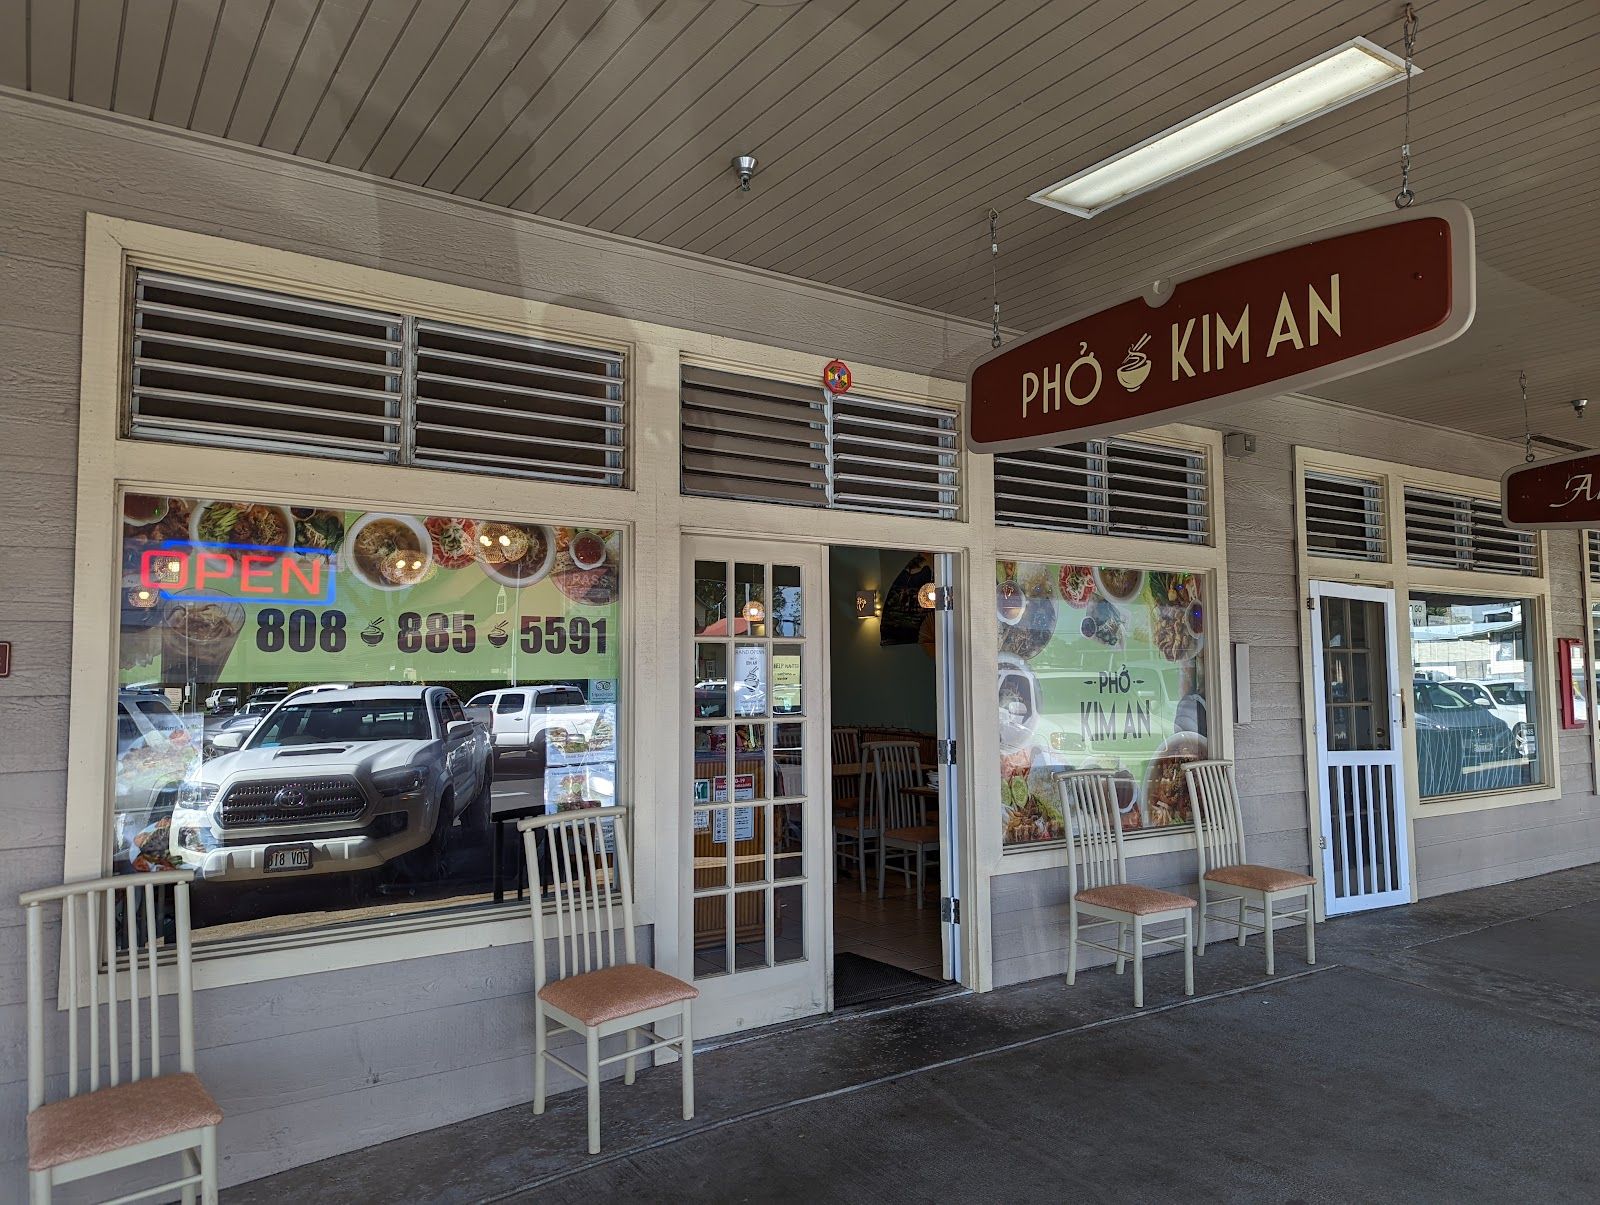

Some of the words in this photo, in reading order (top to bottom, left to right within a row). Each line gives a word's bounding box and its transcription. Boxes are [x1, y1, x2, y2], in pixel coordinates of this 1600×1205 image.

[1171, 303, 1250, 382] KIM
[1266, 273, 1342, 358] AN
[1549, 473, 1600, 508] A
[140, 550, 321, 595] OPEN
[256, 608, 347, 653] 808
[397, 611, 477, 654] 885
[520, 615, 607, 655] 5591
[1080, 700, 1117, 742] KIM
[1122, 699, 1151, 740] AN
